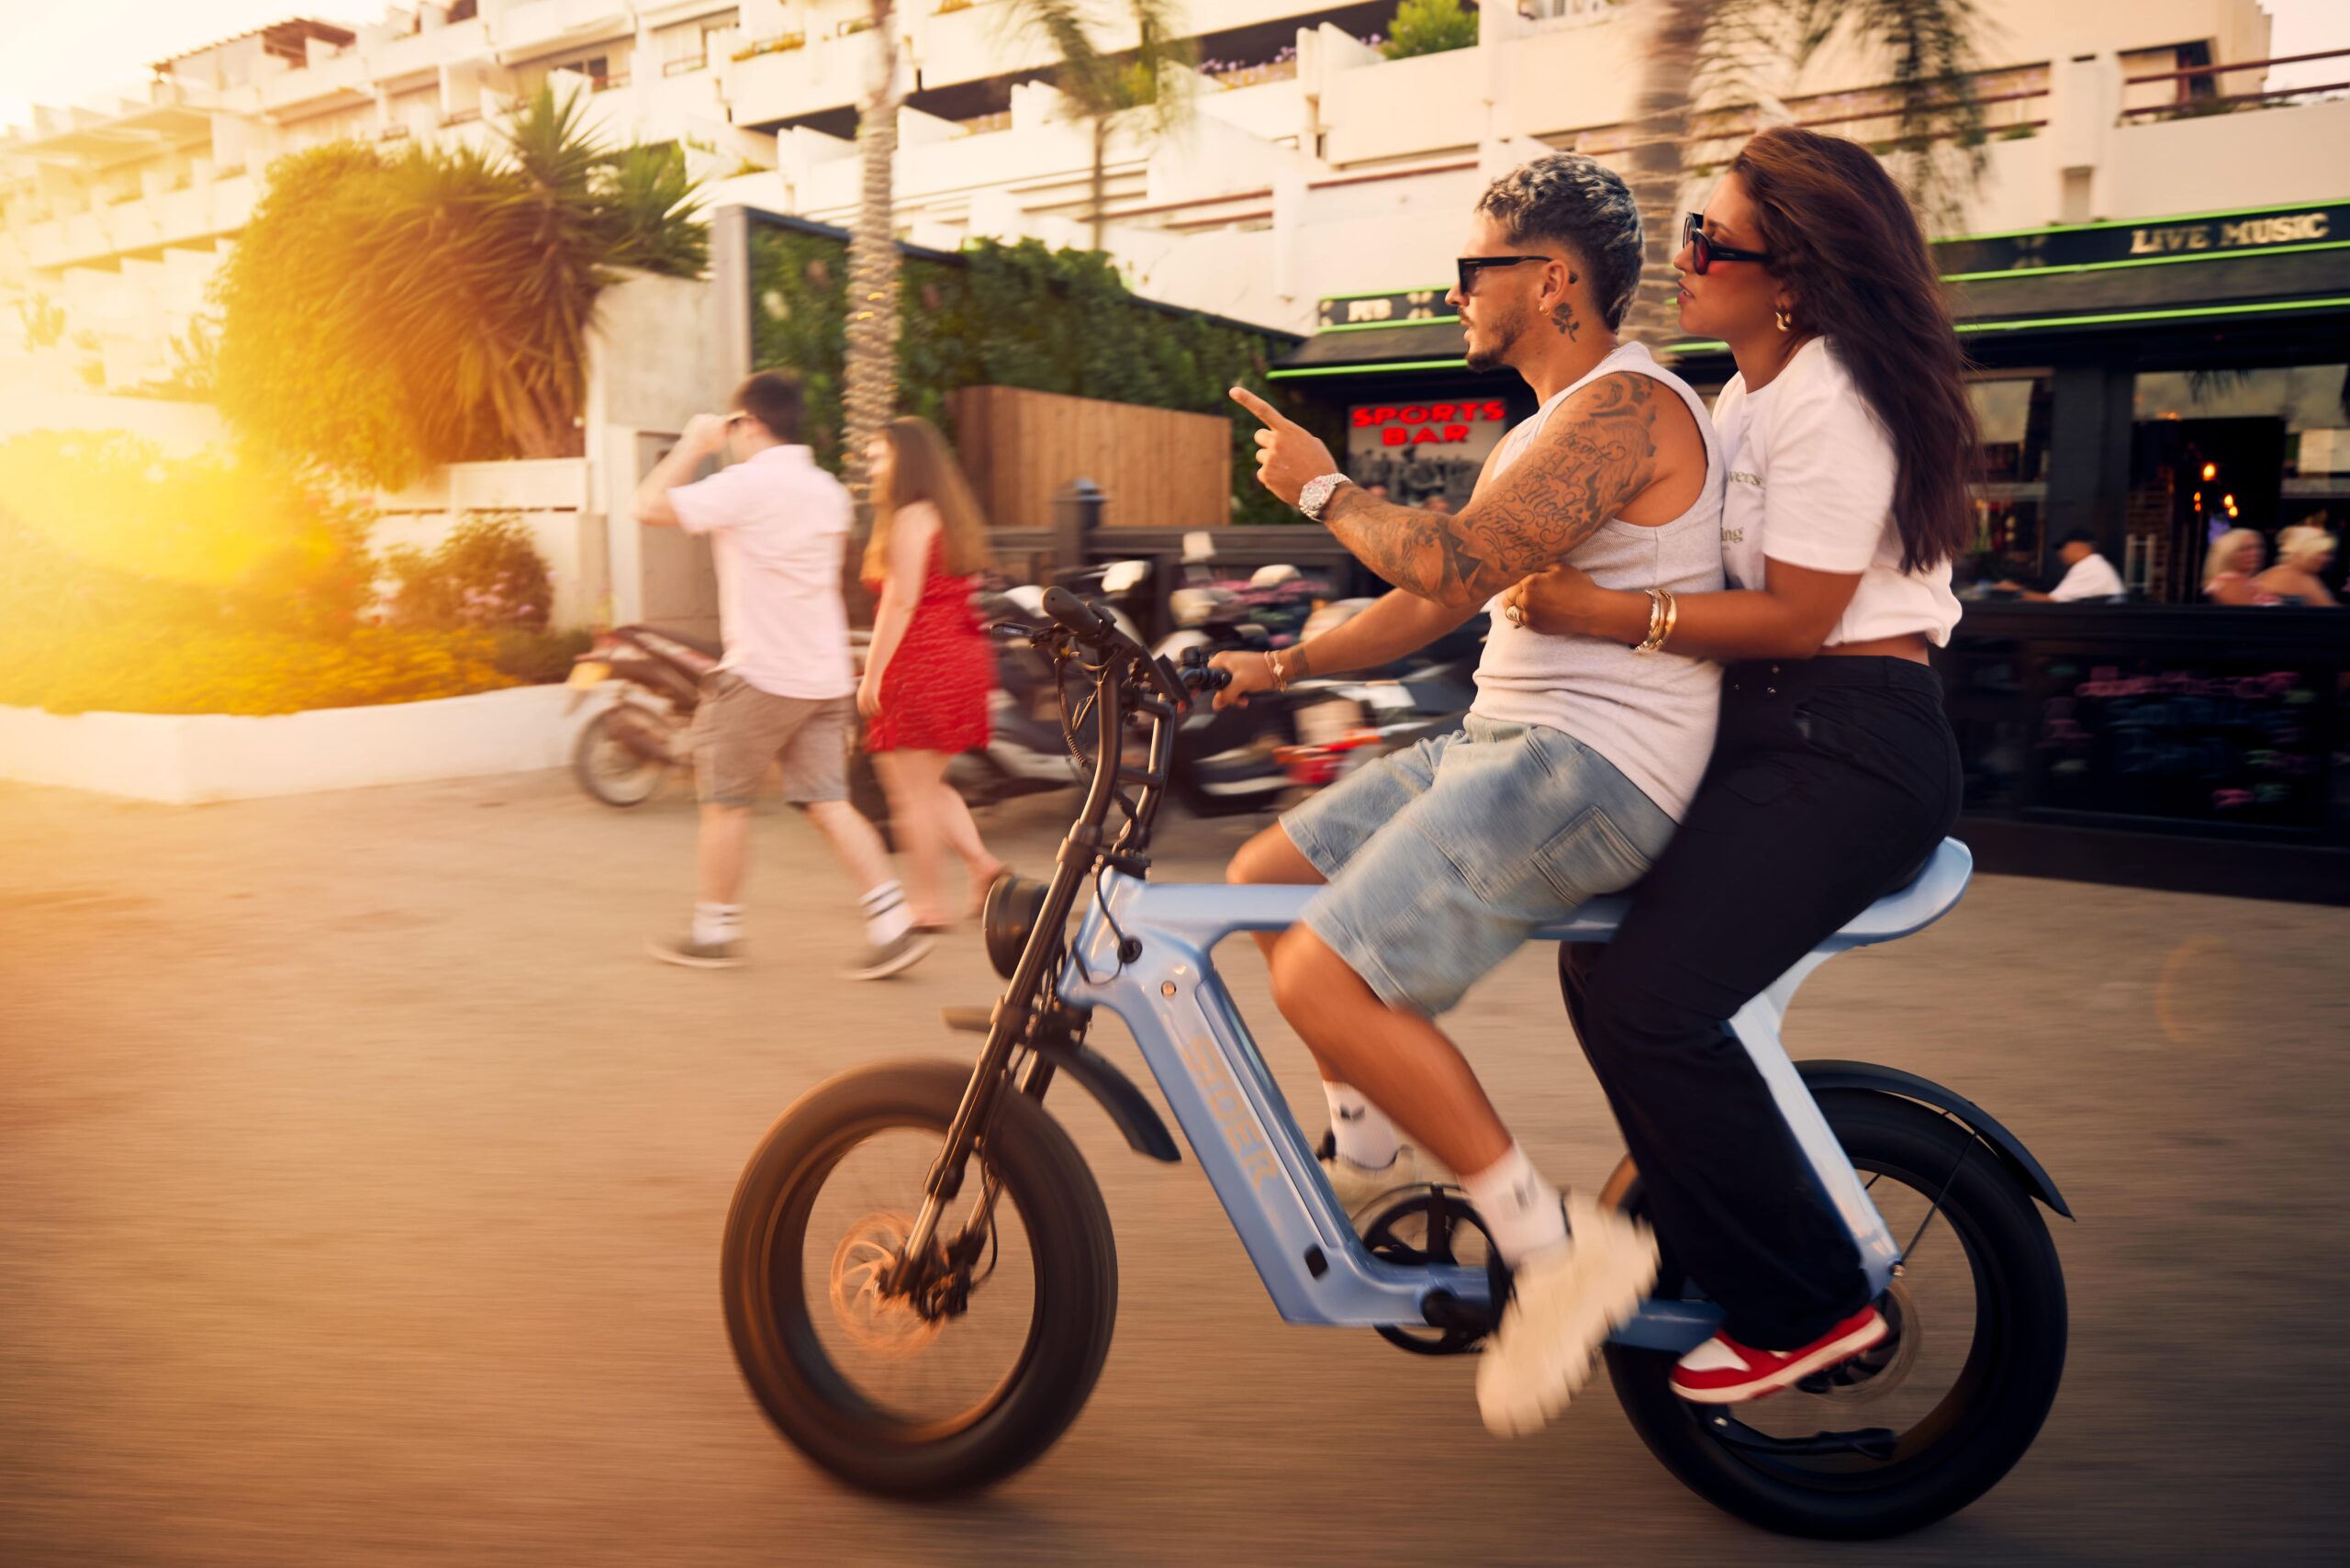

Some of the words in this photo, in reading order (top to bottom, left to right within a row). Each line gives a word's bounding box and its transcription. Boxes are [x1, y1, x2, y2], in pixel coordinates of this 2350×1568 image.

[2130, 226, 2210, 254] LIVE
[2219, 212, 2330, 246] MUSIC
[1350, 400, 1506, 428] SPORTS
[1382, 424, 1470, 446] BAR
